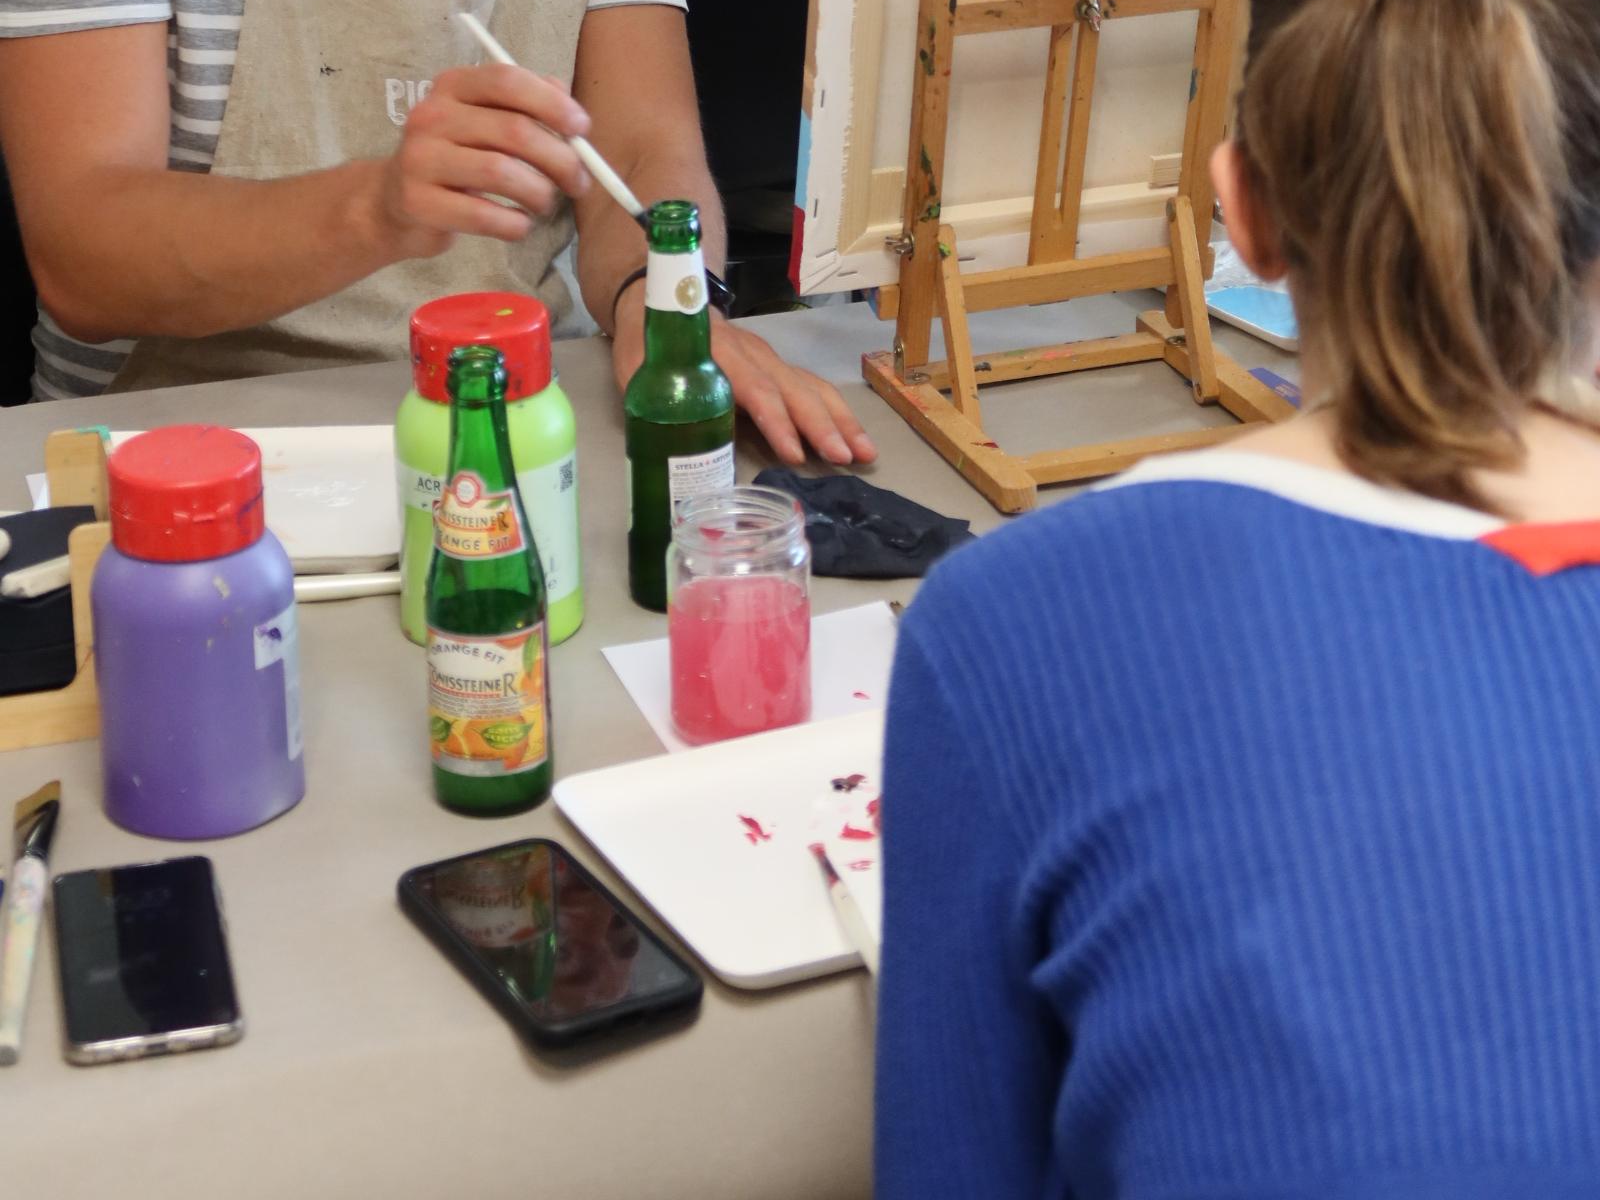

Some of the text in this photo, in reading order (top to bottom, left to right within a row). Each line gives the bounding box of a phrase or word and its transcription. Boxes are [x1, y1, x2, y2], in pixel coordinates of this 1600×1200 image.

[675, 462, 704, 471] STELLA
[439, 529, 480, 550] ANGE
[431, 643, 505, 664] ORANGE FIT
